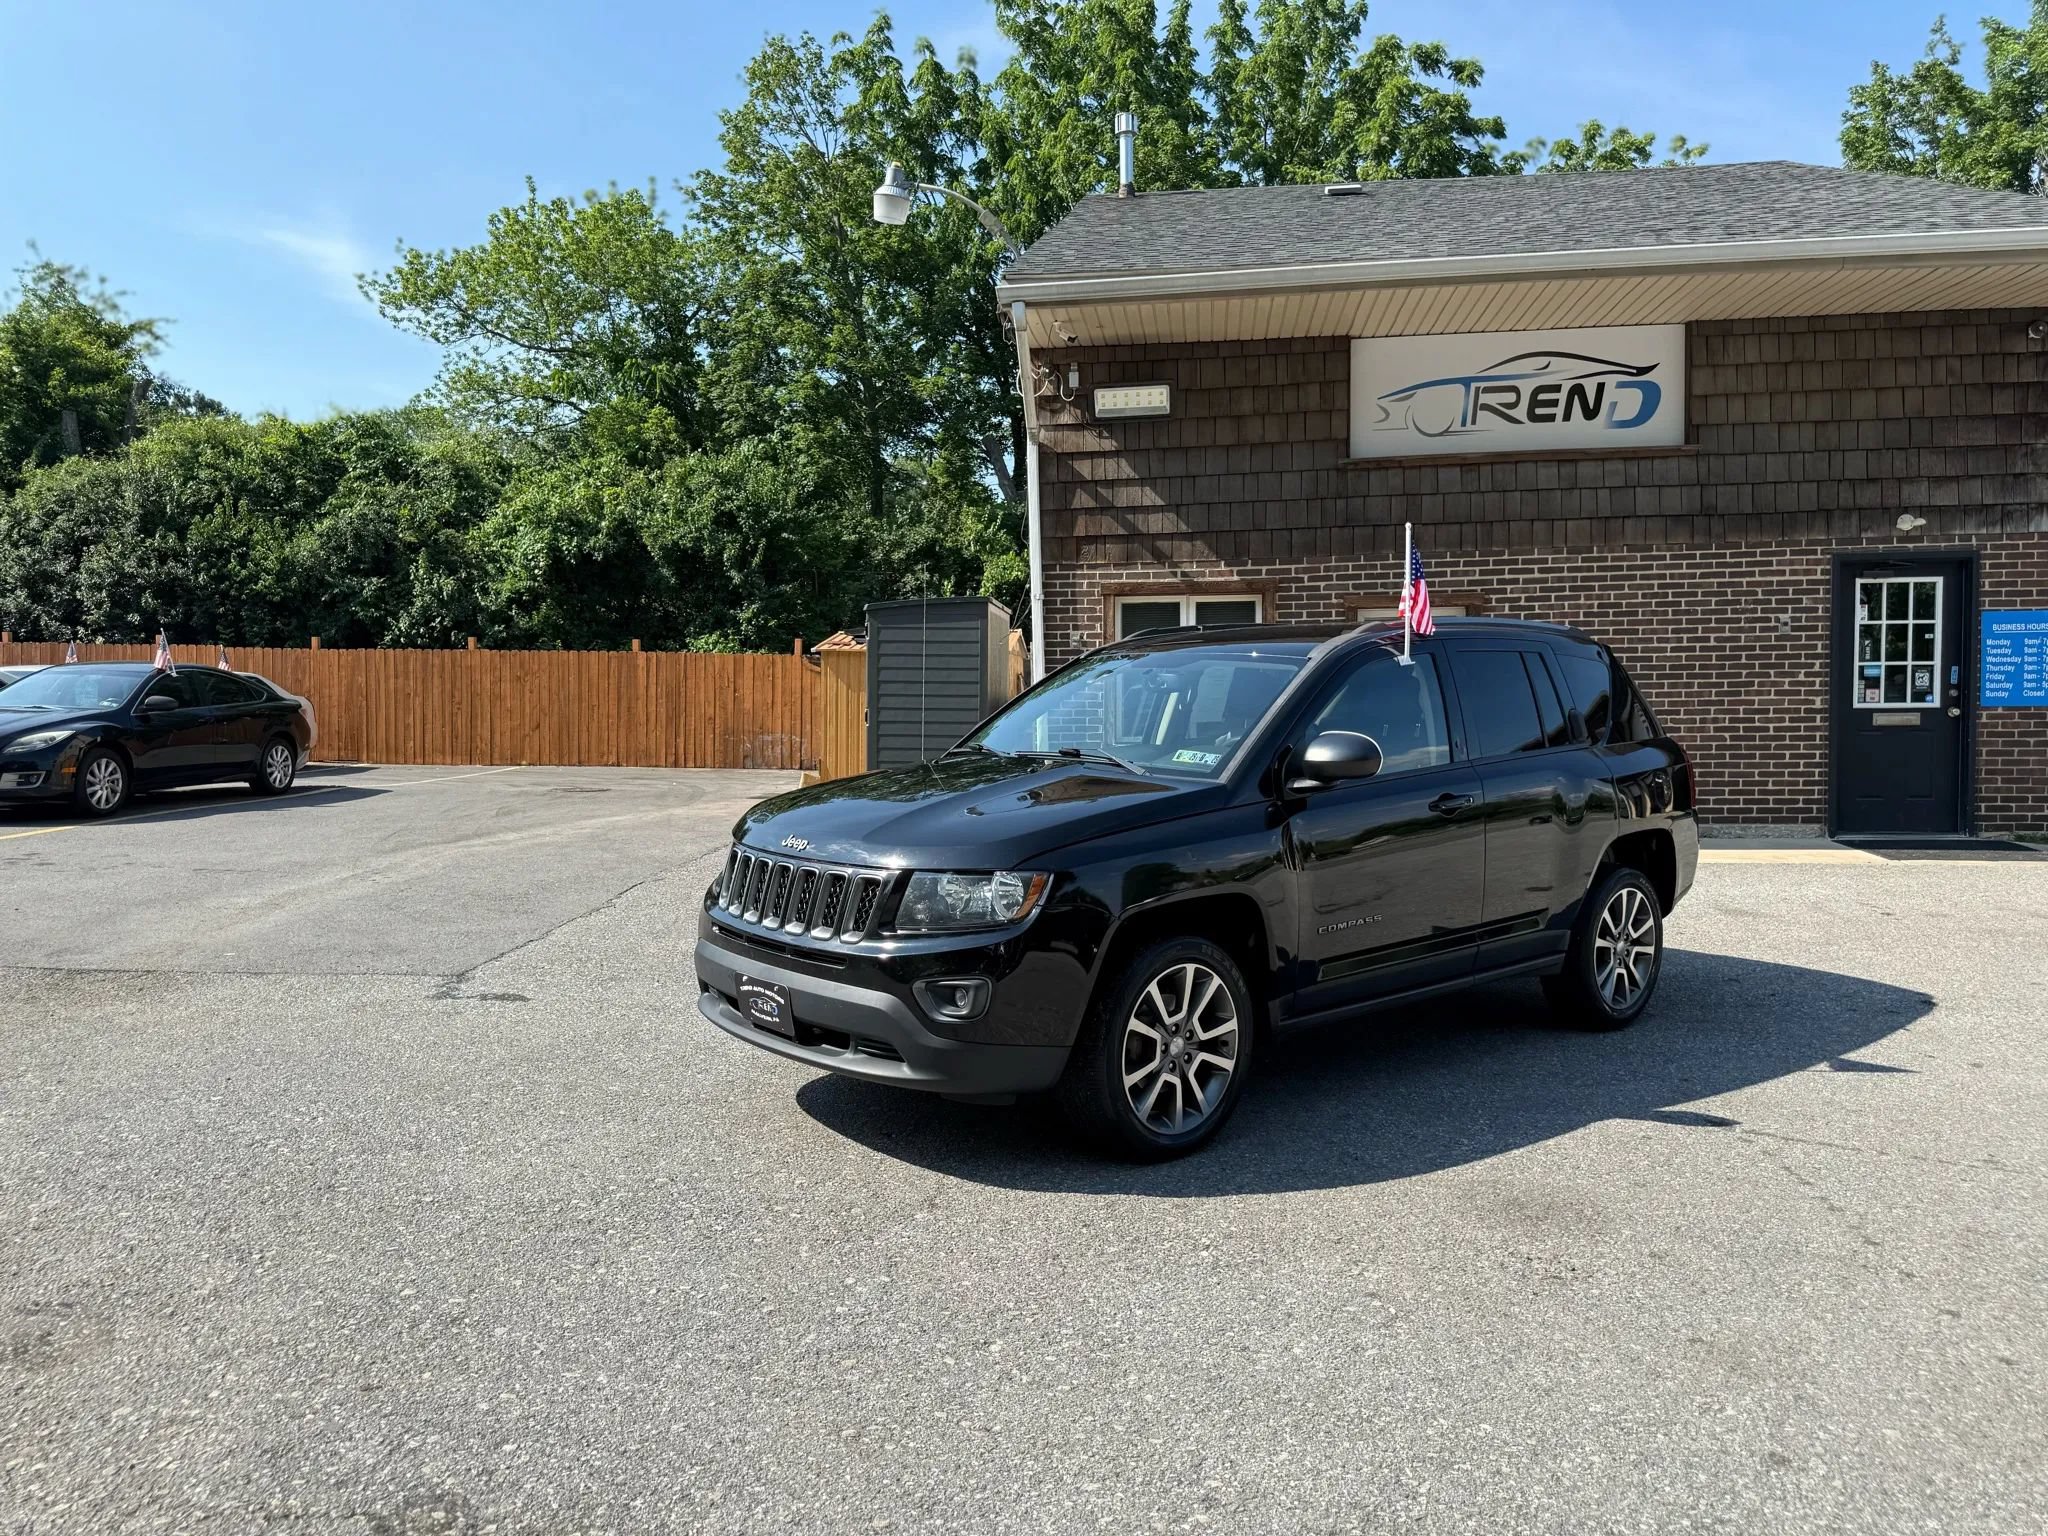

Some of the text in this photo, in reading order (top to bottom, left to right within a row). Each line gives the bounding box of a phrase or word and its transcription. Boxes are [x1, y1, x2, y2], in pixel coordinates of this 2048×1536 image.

[1456, 374, 1662, 429] TREND
[1992, 623, 2026, 631] BUSINESS
[1986, 638, 2011, 646] Monday
[1986, 647, 2012, 655] Tuesday
[1986, 664, 2015, 672] Thursday
[1985, 673, 2006, 681] Friday
[1985, 681, 2013, 689] Saturday
[1985, 689, 2045, 698] Sunday Closed
[781, 834, 809, 852] Jeep
[1317, 914, 1384, 935] COMPASS
